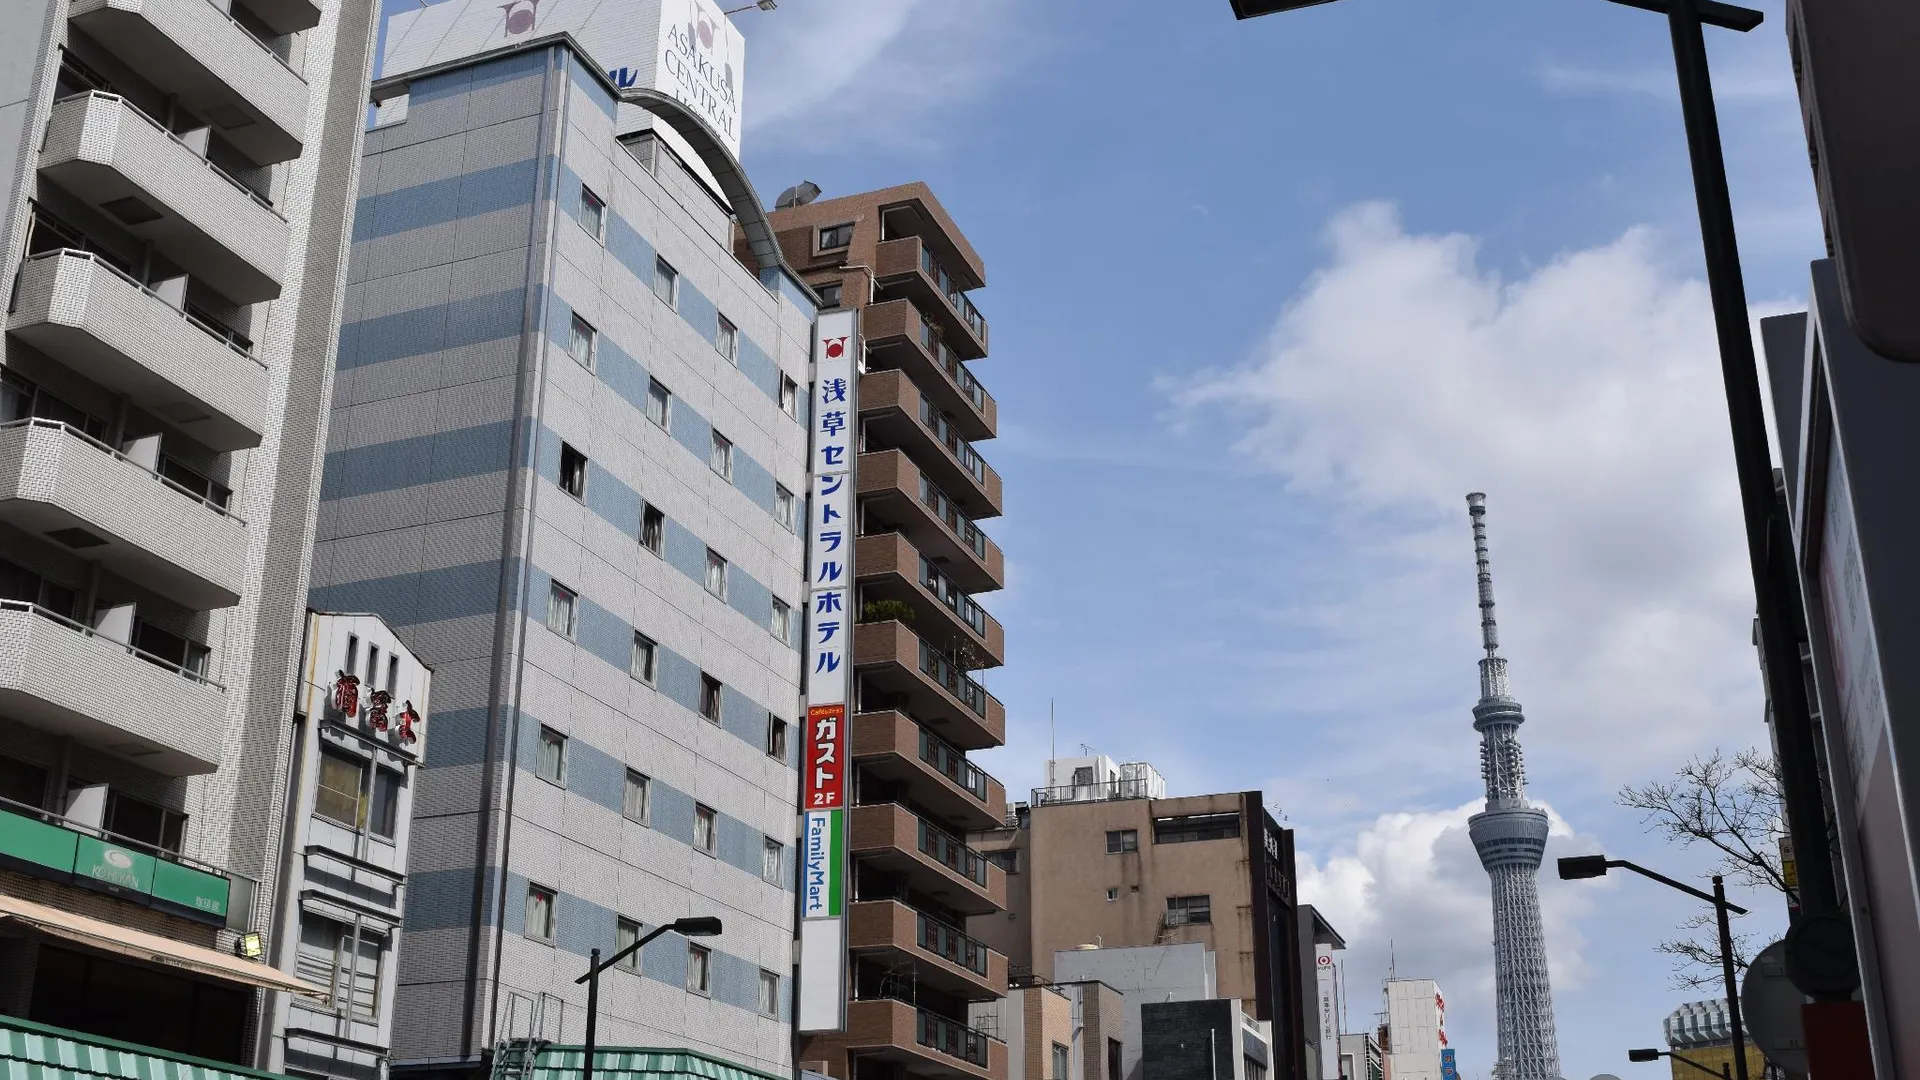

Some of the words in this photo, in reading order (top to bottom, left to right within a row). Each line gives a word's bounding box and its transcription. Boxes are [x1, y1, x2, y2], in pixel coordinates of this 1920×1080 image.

[665, 49, 736, 142] CENTRAL
[668, 23, 736, 114] ASAKUSA
[815, 378, 847, 674] 浅草セントラルホテル
[813, 792, 836, 805] 2F
[815, 717, 837, 789] ガスト
[807, 817, 826, 910] FamilyMart
